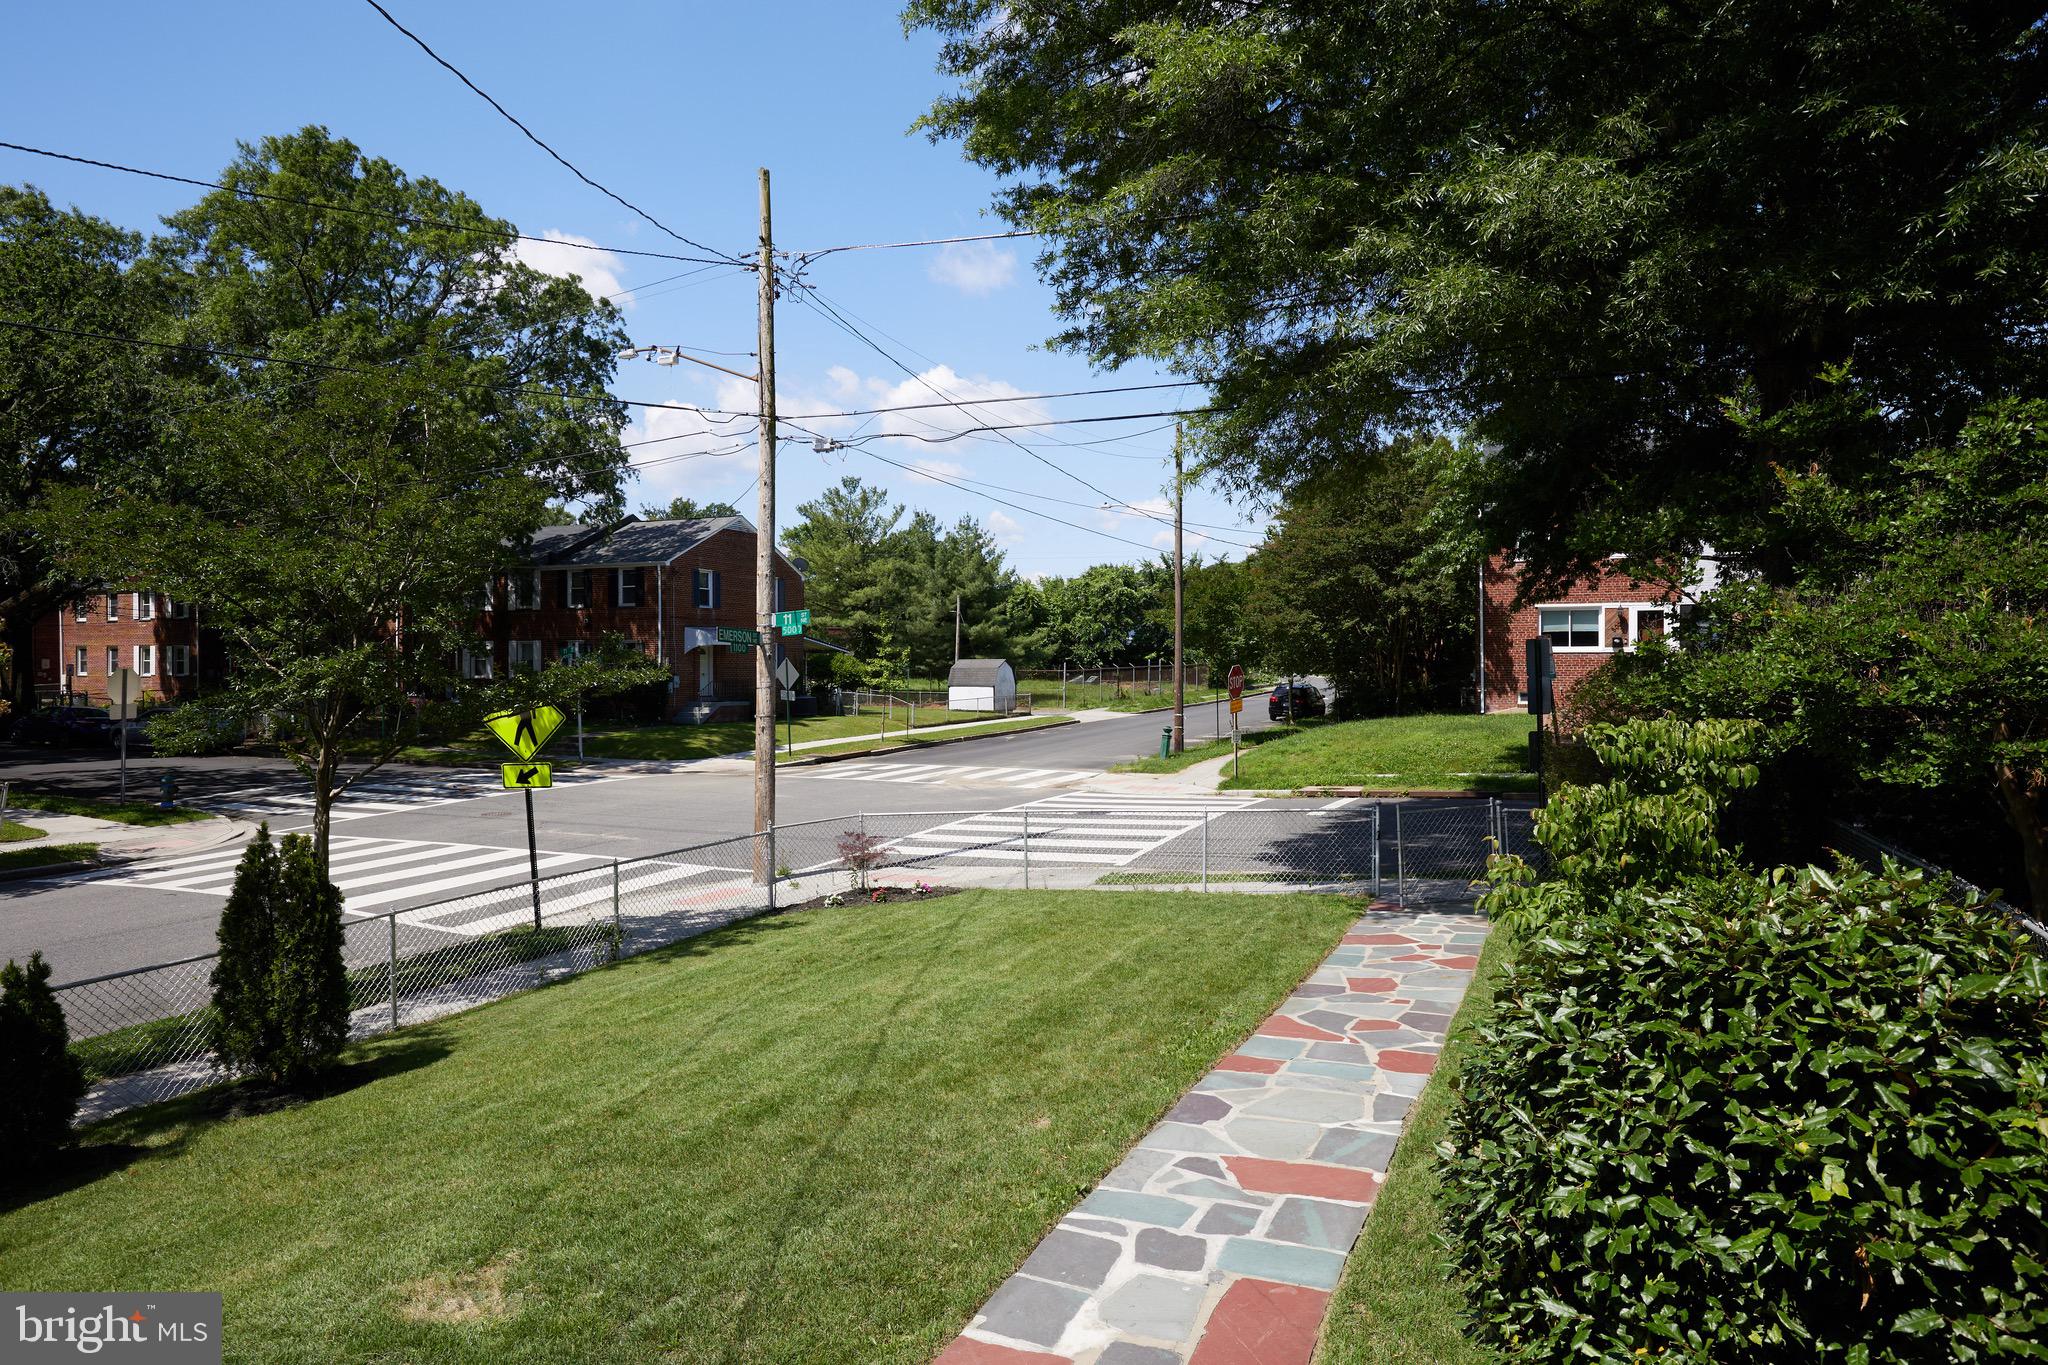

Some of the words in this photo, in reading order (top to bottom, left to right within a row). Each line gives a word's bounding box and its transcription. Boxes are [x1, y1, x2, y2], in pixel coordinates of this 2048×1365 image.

[783, 613, 792, 625] 11
[719, 628, 752, 643] EMERSON
[783, 625, 797, 634] 500
[1229, 676, 1243, 689] STOP
